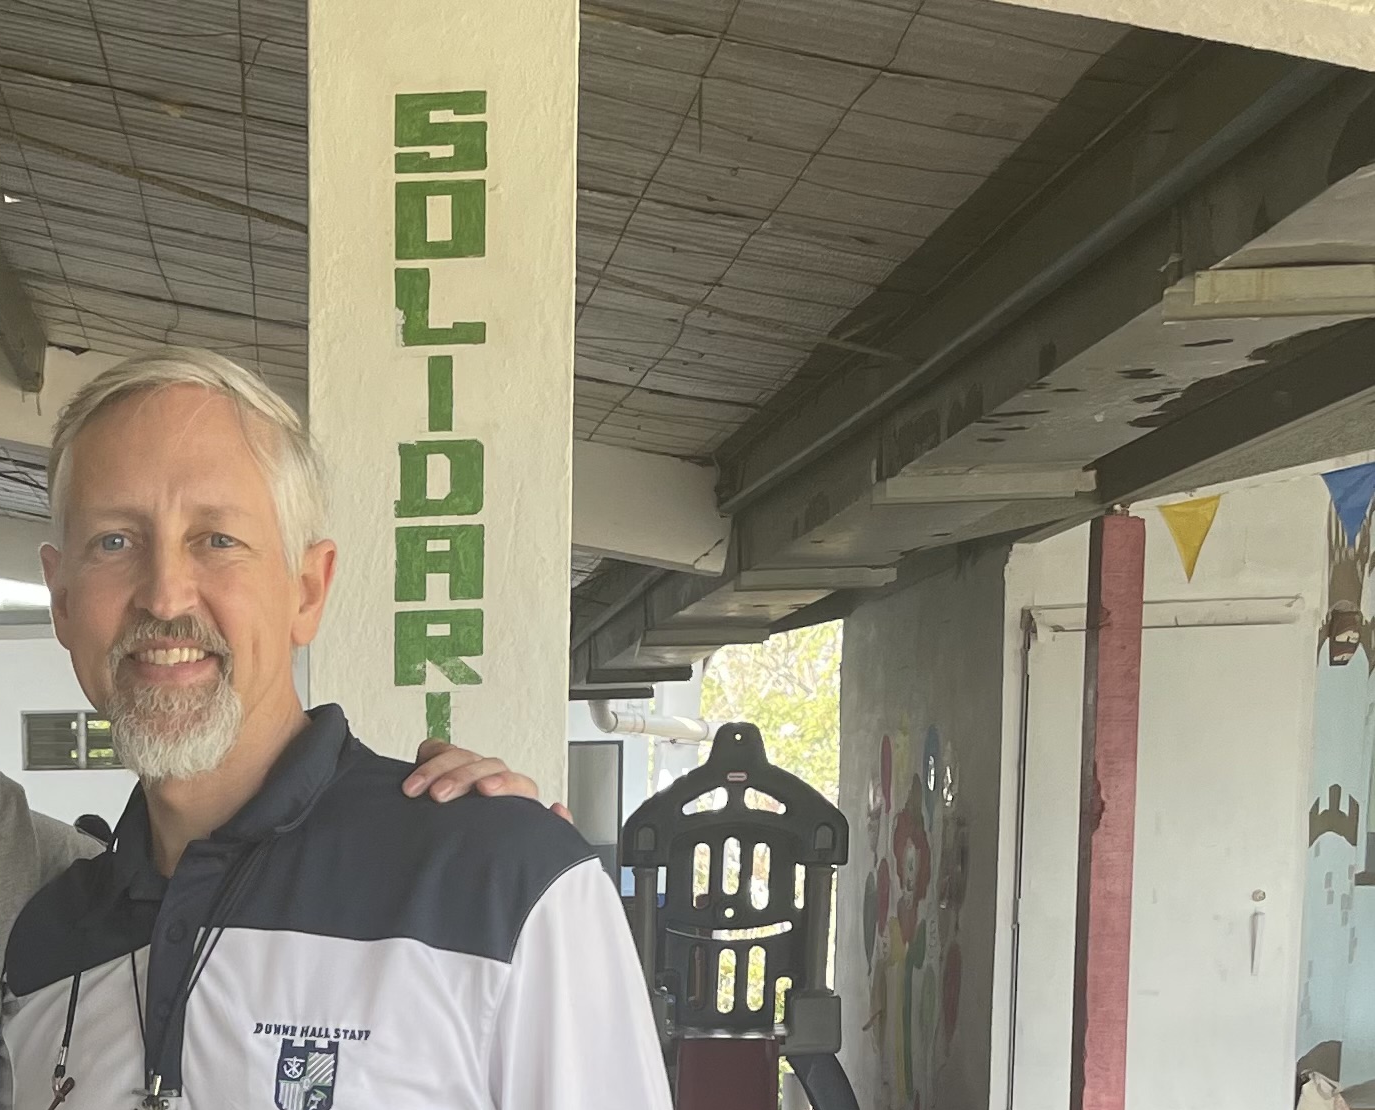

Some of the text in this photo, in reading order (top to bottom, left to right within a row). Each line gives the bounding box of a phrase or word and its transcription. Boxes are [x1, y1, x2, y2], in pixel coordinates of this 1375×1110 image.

[253, 1022, 371, 1040] DUNNE HALL STAFF
